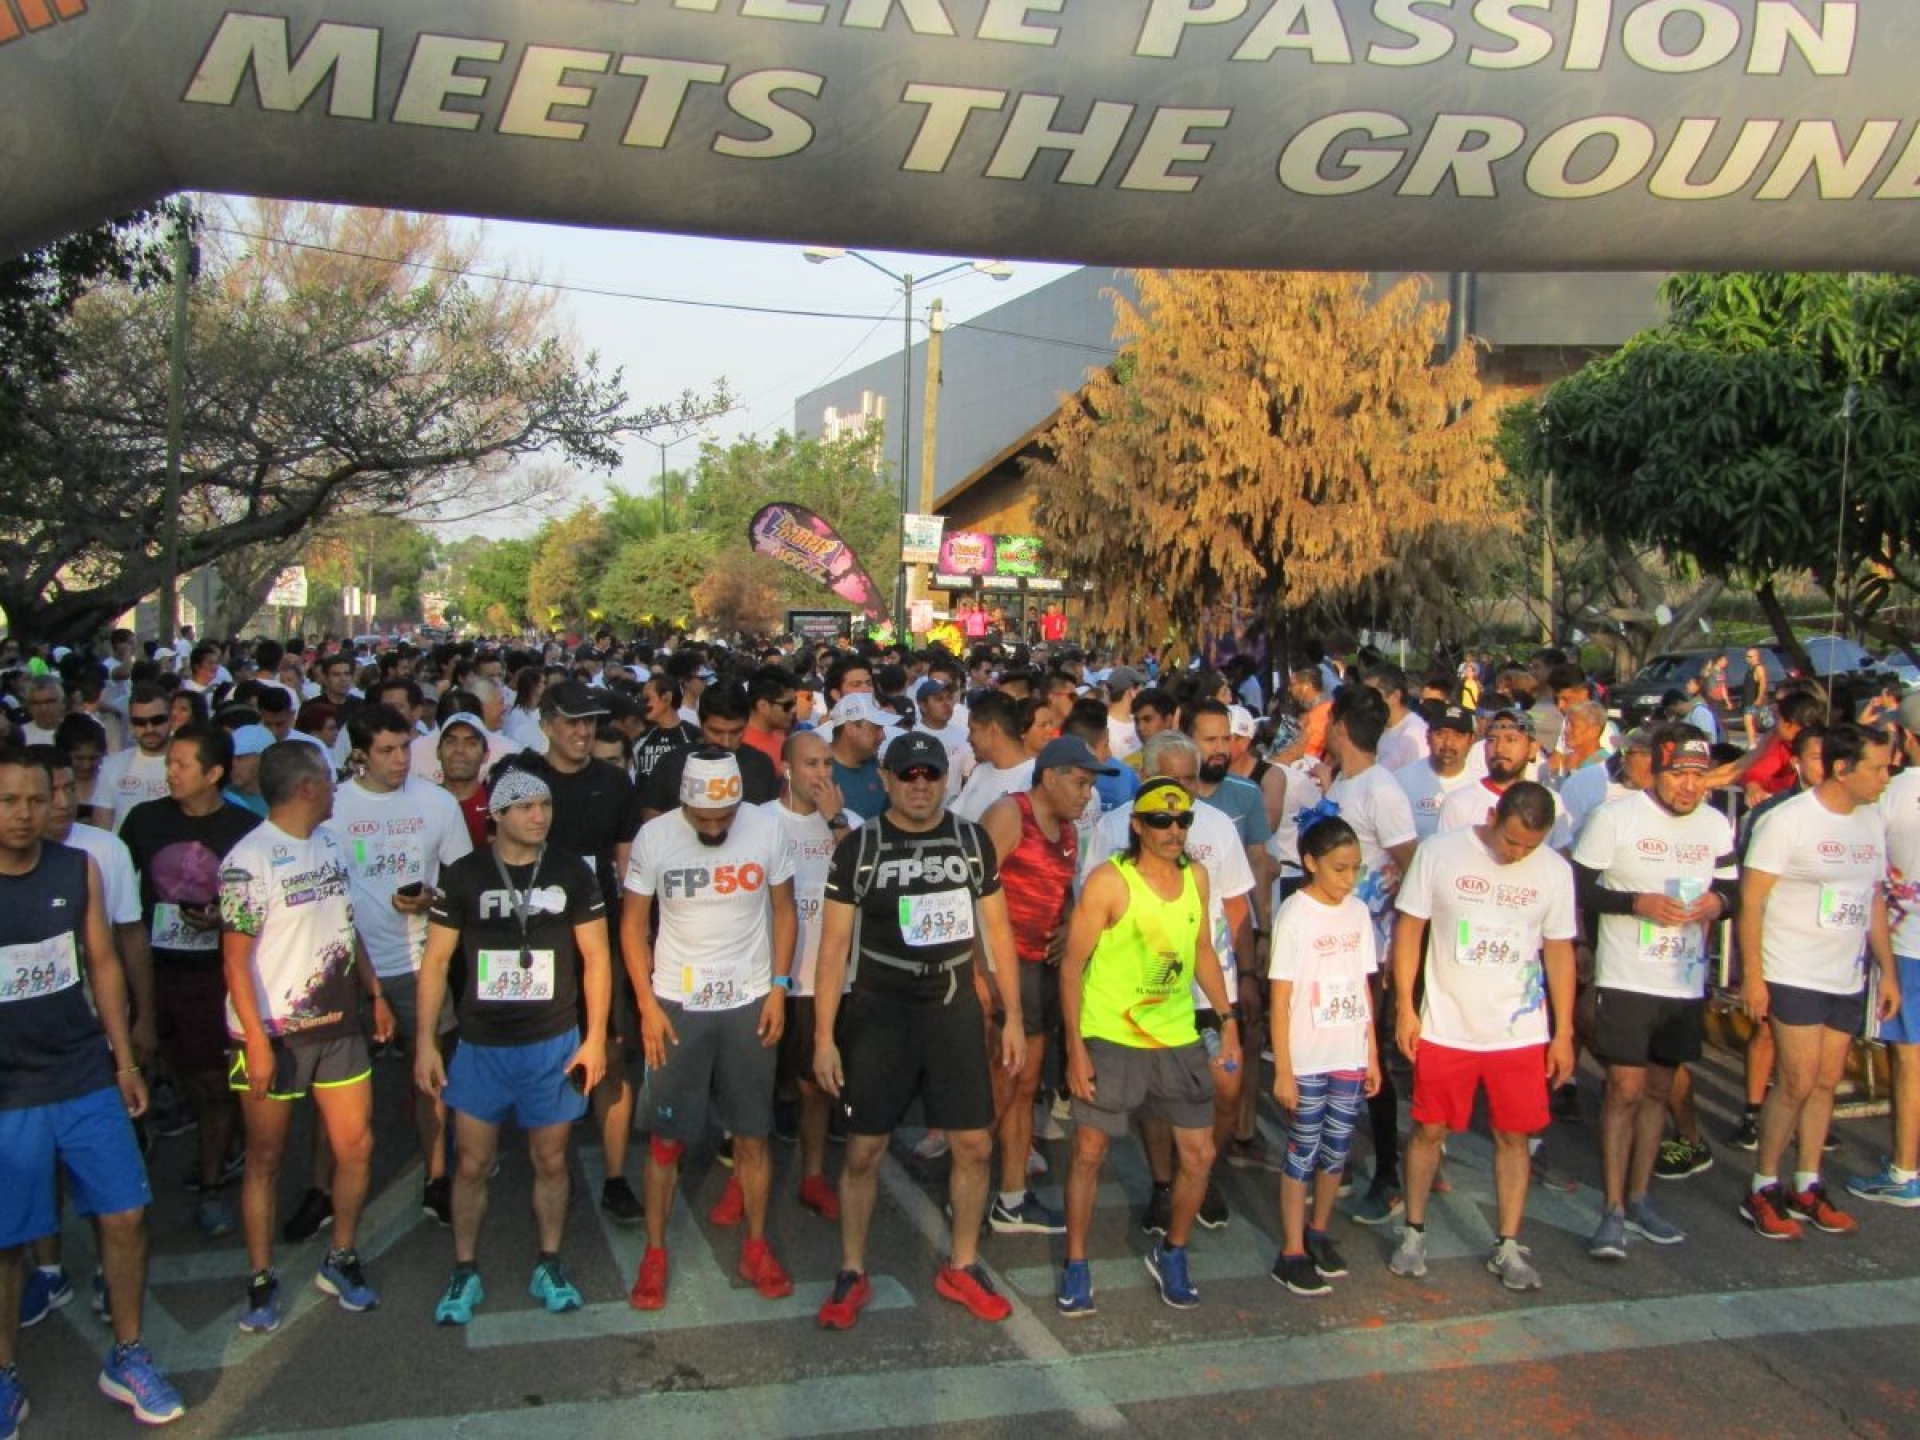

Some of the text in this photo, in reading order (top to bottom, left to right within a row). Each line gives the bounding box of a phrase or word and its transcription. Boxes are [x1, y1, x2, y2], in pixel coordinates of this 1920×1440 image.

[1133, 0, 1857, 76] PASSION
[182, 10, 825, 159] MEETS
[899, 82, 1231, 193] THE
[663, 861, 765, 898] FP50
[876, 855, 969, 889] FP50
[921, 911, 956, 930] 435
[703, 979, 734, 996] 421
